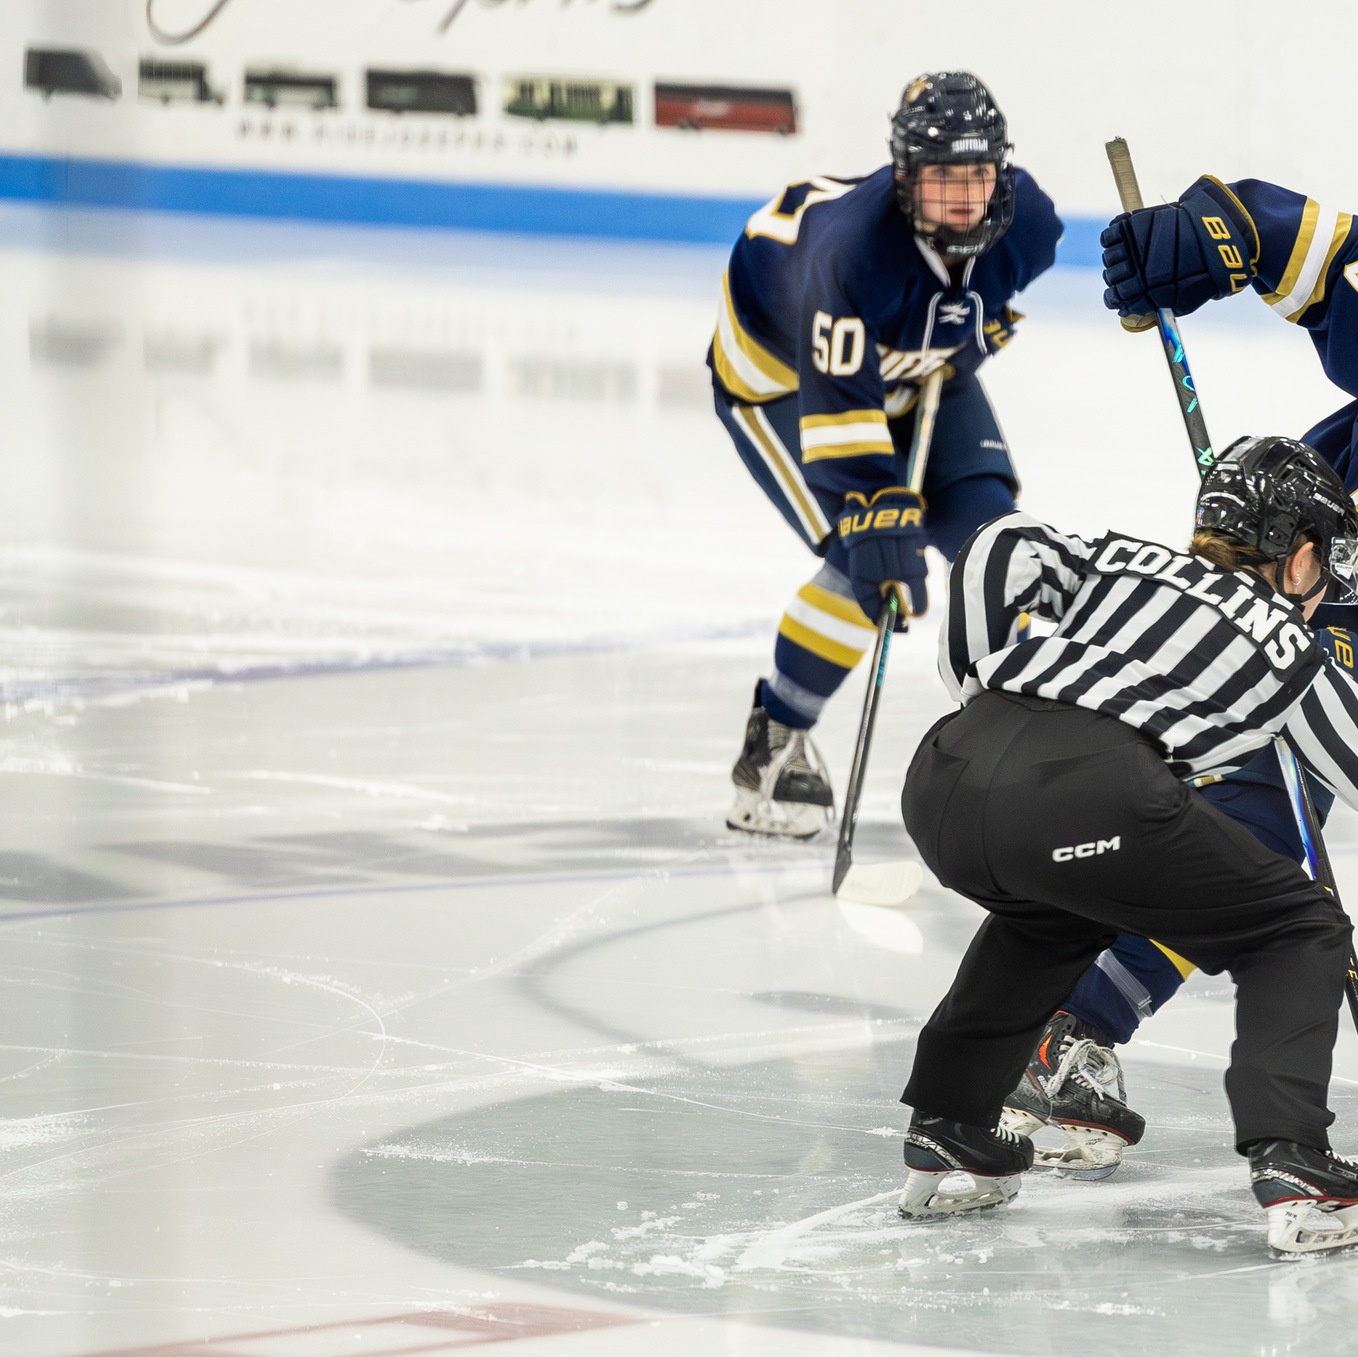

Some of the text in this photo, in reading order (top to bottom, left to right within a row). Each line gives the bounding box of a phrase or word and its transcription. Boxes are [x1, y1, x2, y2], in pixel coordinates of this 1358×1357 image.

[812, 309, 866, 376] 50
[1095, 539, 1311, 670] COLLINS
[1052, 835, 1121, 863] CCM
